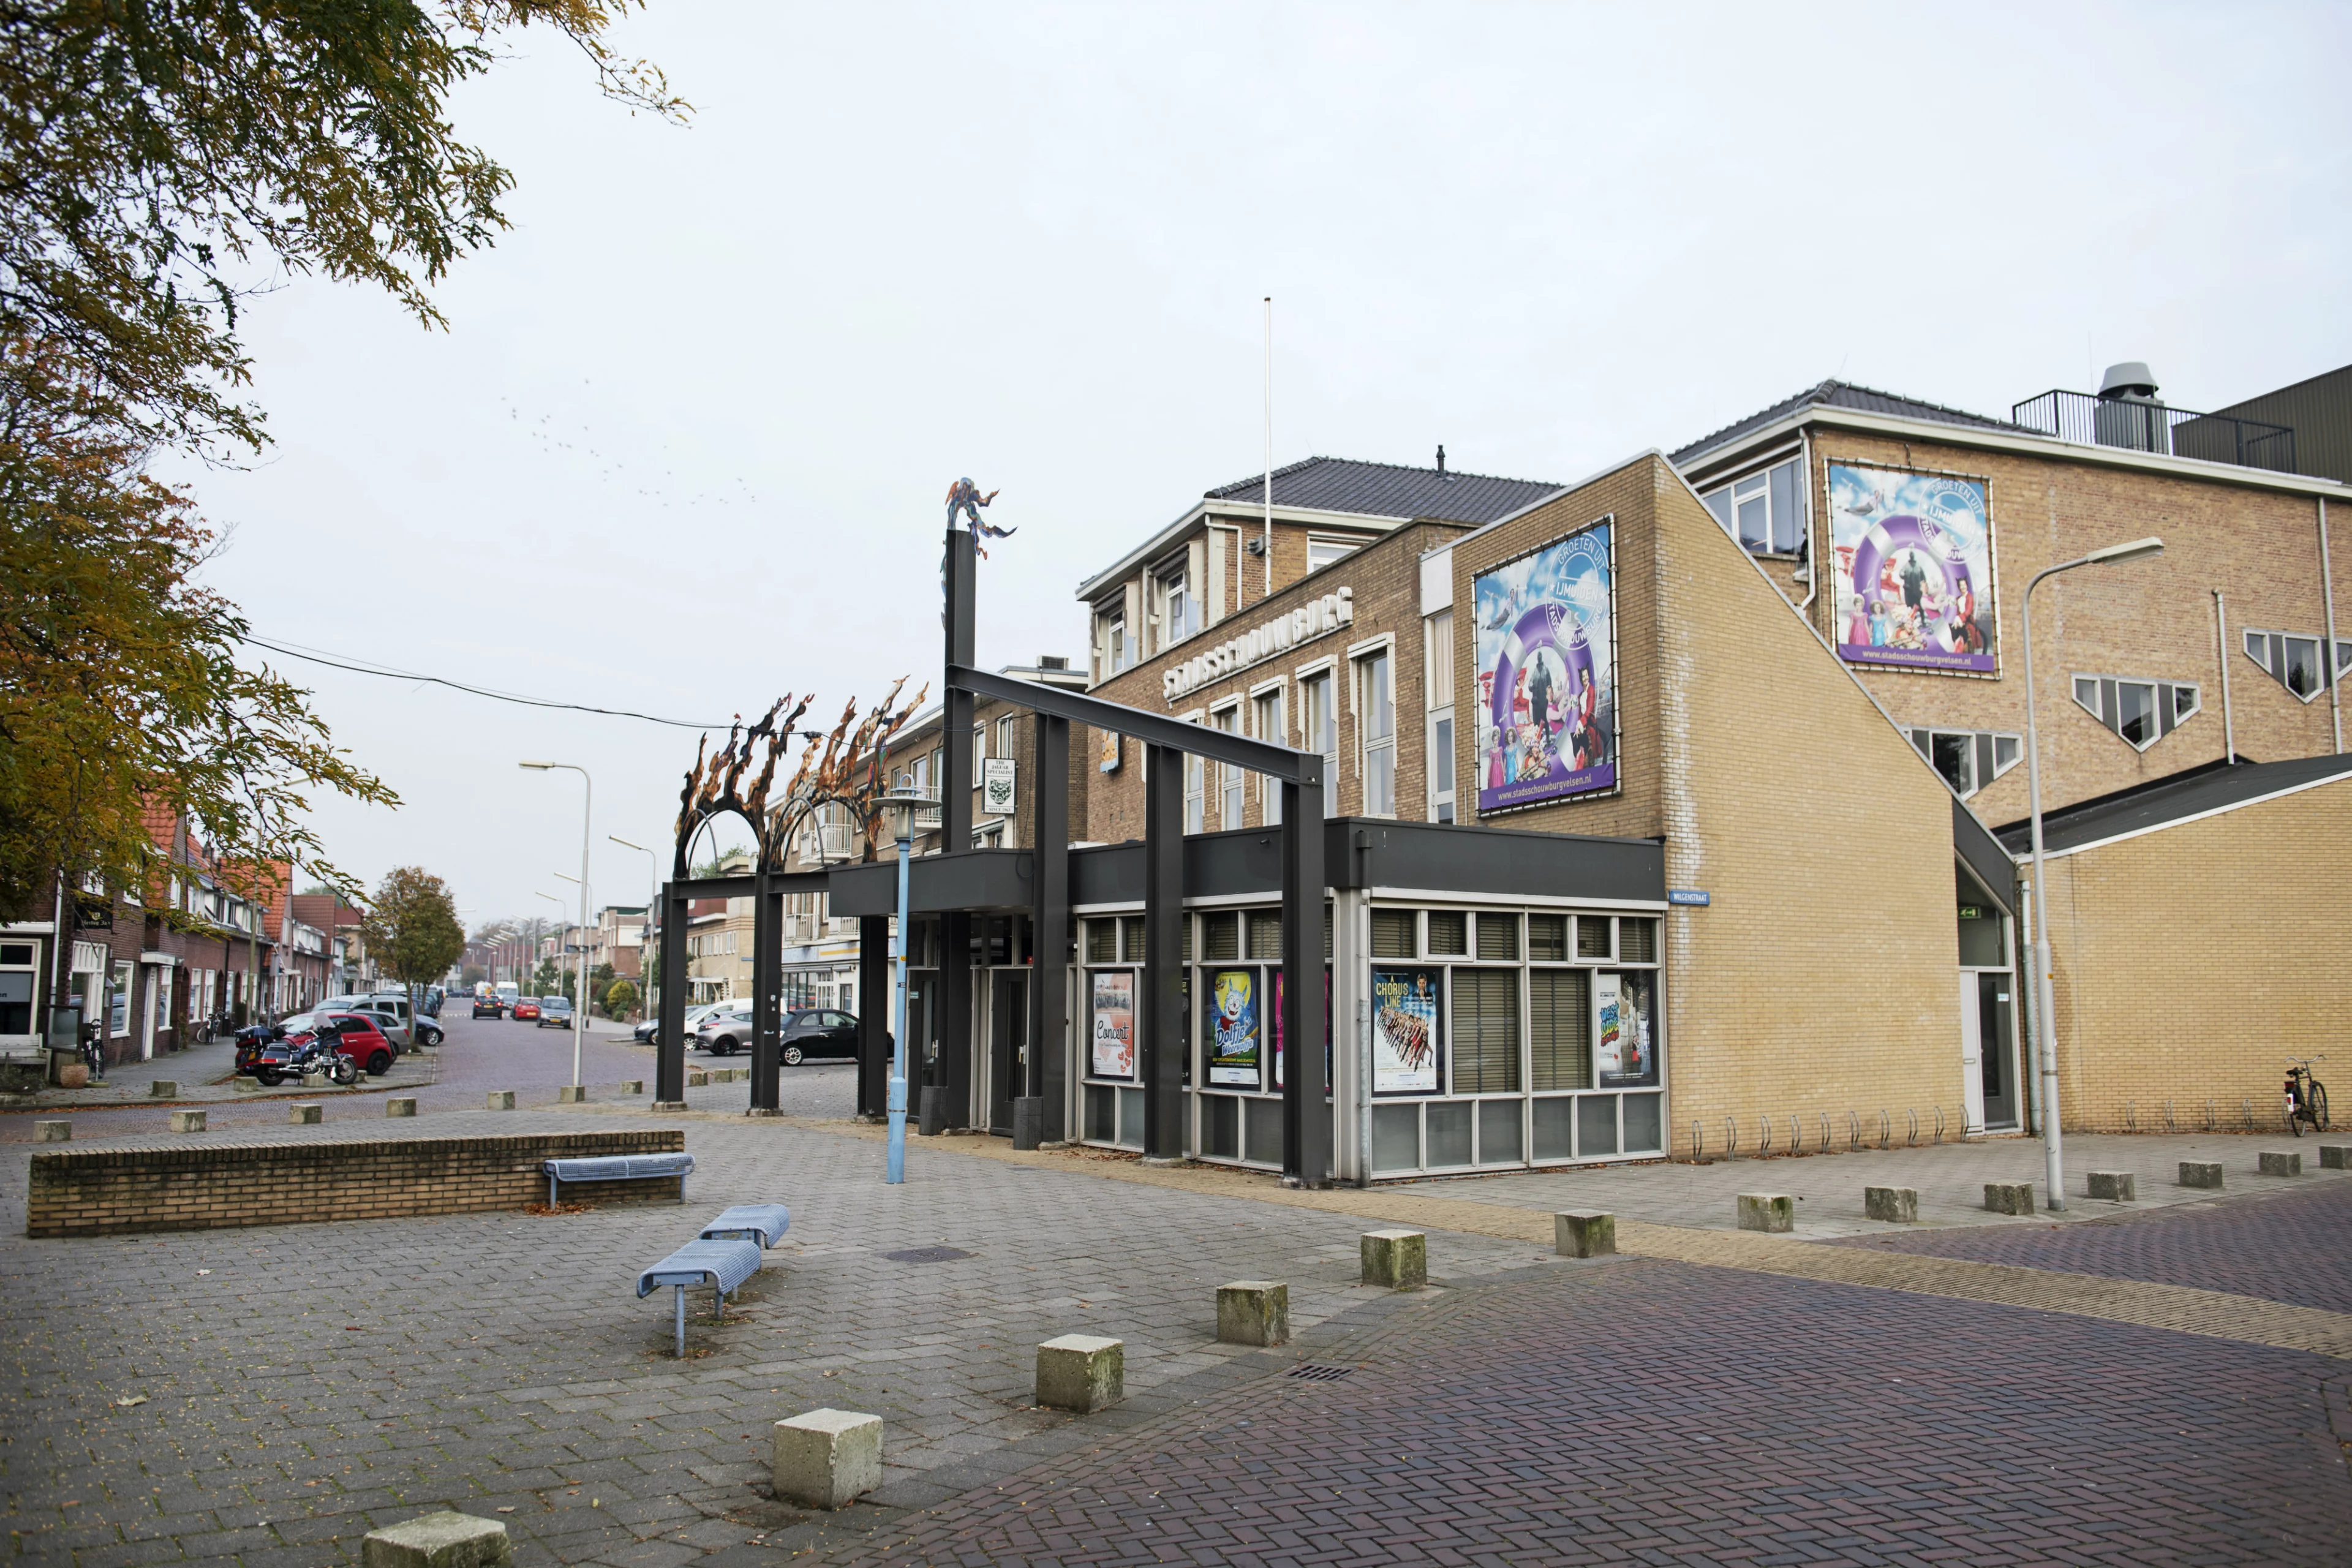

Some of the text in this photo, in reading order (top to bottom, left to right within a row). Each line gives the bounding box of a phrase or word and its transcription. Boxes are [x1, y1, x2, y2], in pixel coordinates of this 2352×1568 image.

[1932, 481, 1983, 514] GROETEN UIT
[1558, 537, 1605, 570] GROETEN UIT
[1556, 582, 1599, 601] IJMUIDEN
[1163, 586, 1353, 698] STADSSCHOUWBURG
[1862, 650, 1971, 665] www.stadsschouwburgvelsen.nl
[1498, 774, 1591, 801] www.stadsschouwburgvelsen.nl
[1673, 893, 1707, 902] WILGENSTRAAT
[1376, 982, 1408, 996] CHORUS
[1385, 995, 1401, 1008] LINE
[1600, 1001, 1619, 1021] WEST
[1097, 1020, 1129, 1040] Concert
[1216, 1022, 1245, 1046] Dolfje
[1222, 1038, 1254, 1056] Weerwolfje
